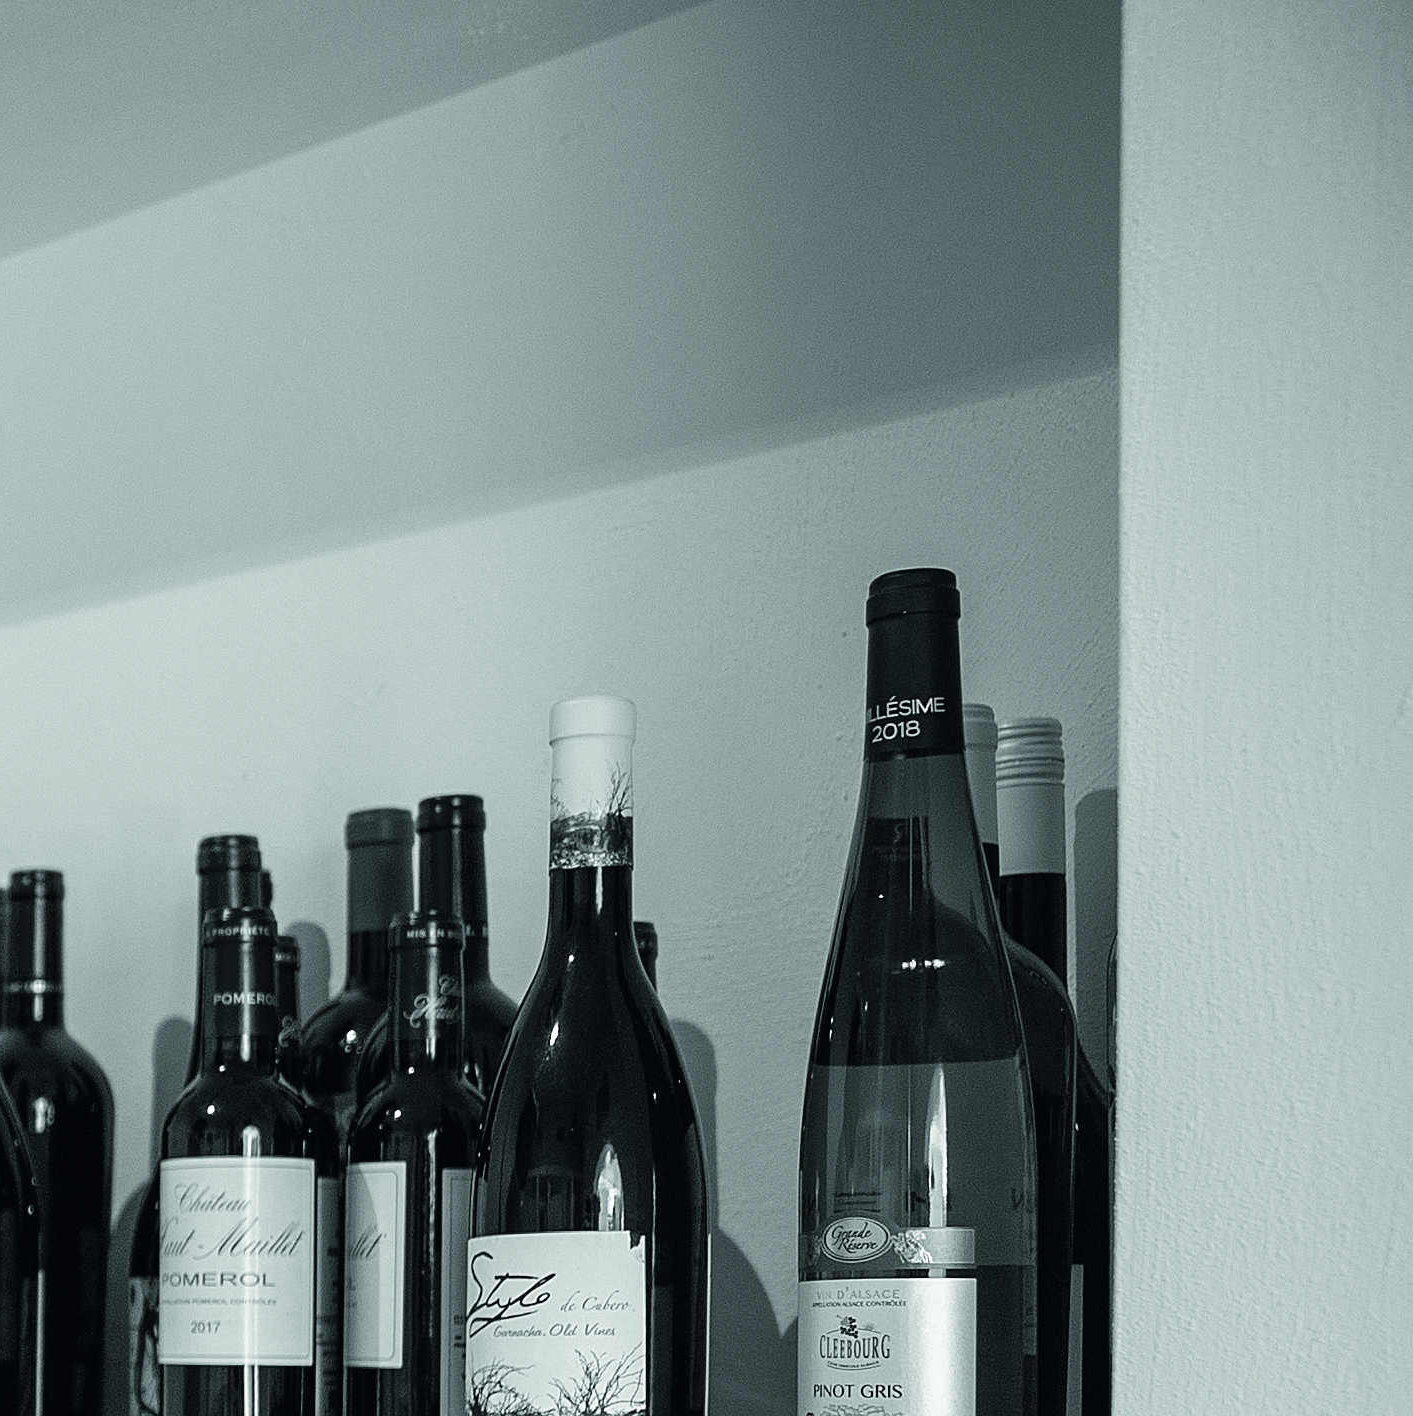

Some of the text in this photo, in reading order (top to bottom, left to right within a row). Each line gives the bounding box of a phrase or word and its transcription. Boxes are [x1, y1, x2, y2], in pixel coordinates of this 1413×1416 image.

[867, 695, 946, 724] LLÉSIME
[872, 720, 921, 743] 2018
[831, 1222, 872, 1246] Grande
[837, 1238, 879, 1254] Réserve
[161, 1272, 275, 1287] POMEROL
[560, 1290, 581, 1312] de
[816, 1286, 900, 1300] VIN D'ALSACE
[191, 1320, 221, 1334] 2017
[549, 1323, 578, 1337] Old
[584, 1322, 616, 1336] Vines
[819, 1334, 891, 1360] CLEEBOURG
[813, 1384, 903, 1398] PINOT GRIS
